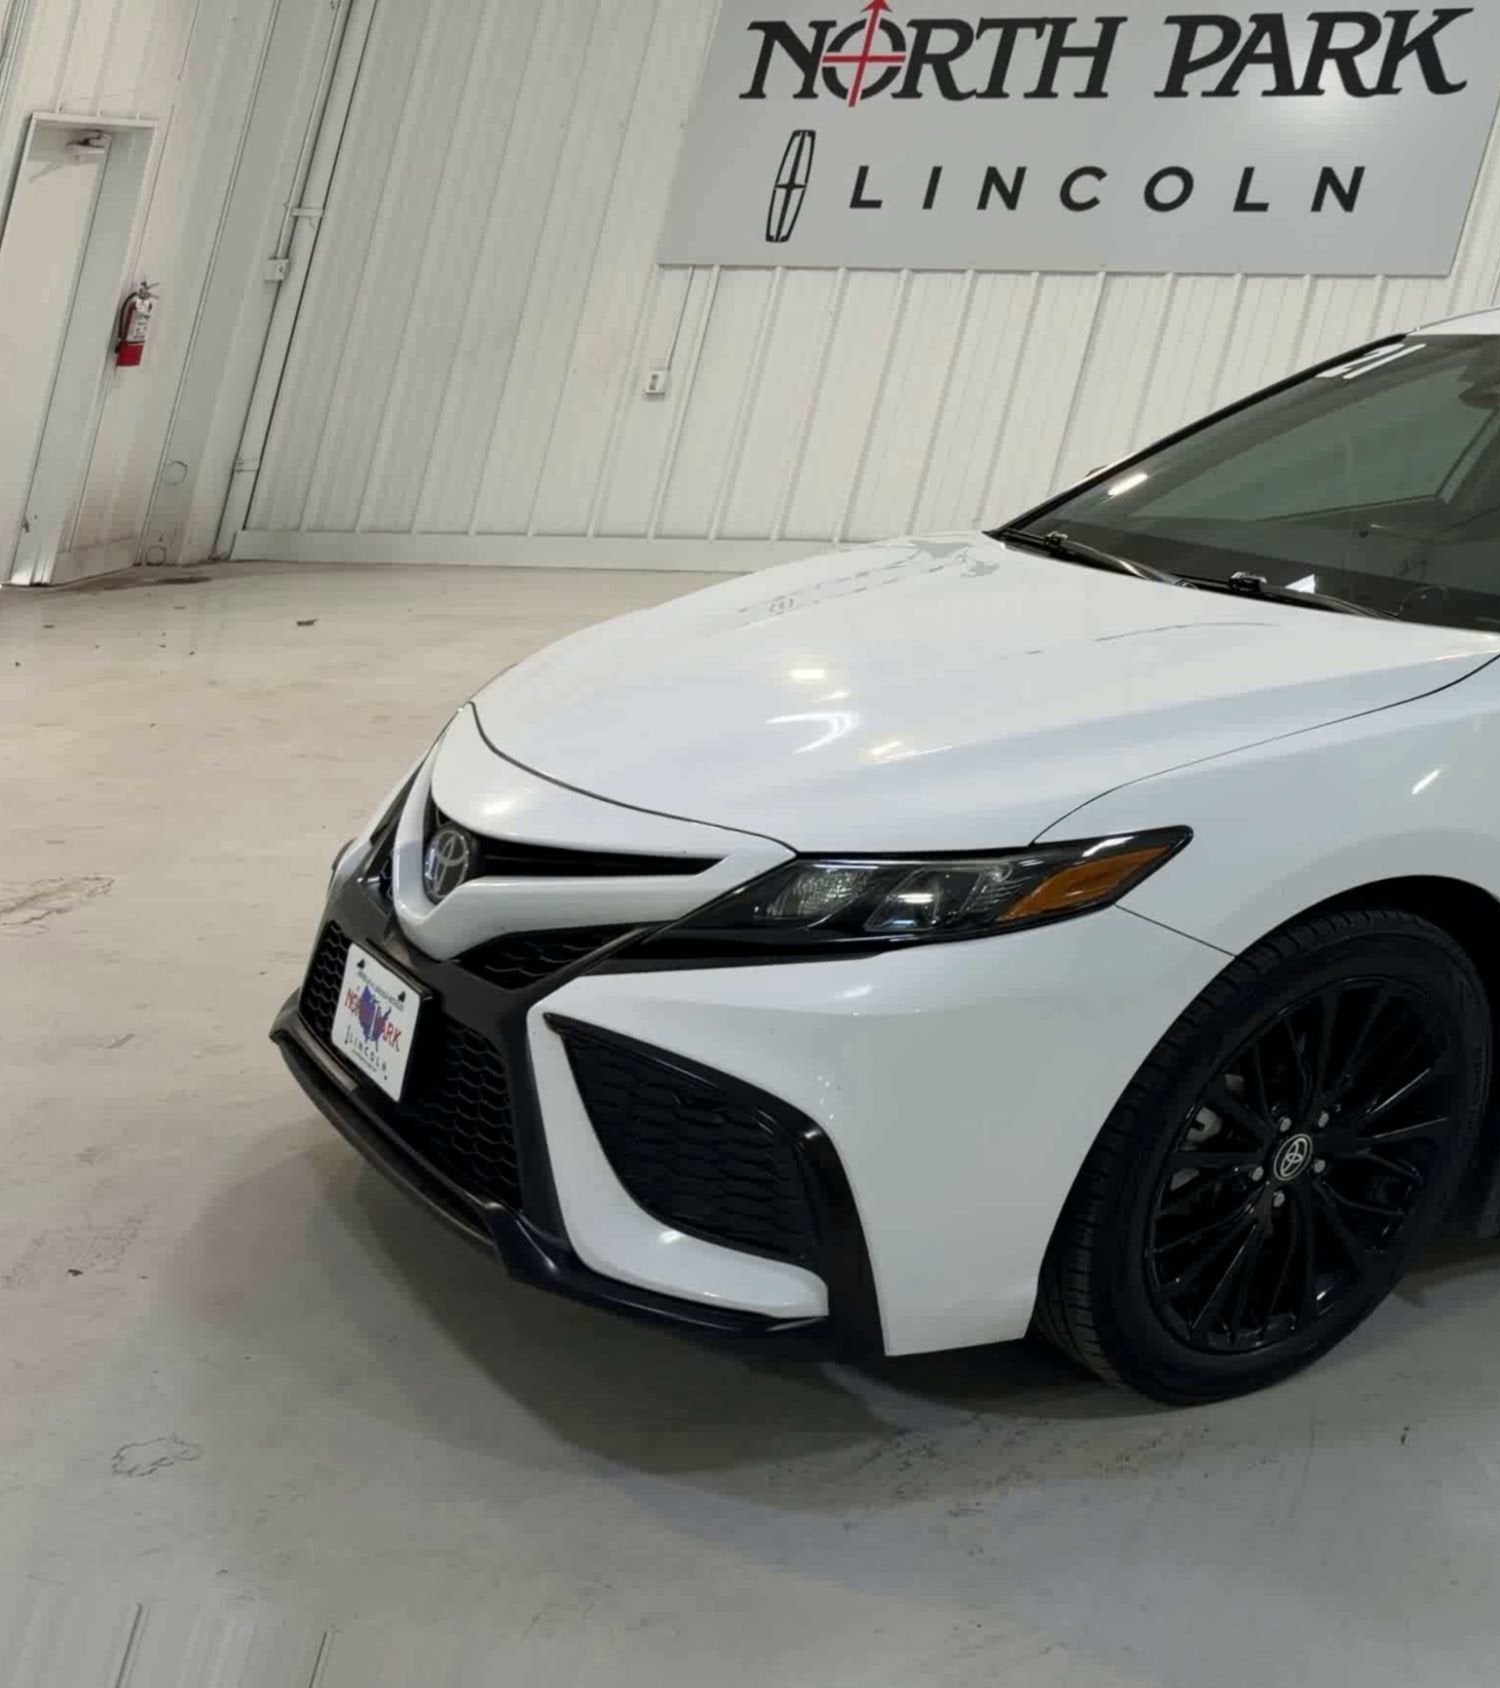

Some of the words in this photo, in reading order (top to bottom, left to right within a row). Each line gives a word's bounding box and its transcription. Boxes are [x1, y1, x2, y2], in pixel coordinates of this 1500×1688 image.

[739, 12, 1128, 102] NORTH
[1153, 8, 1474, 98] PARK
[849, 166, 1365, 212] LINCOLN
